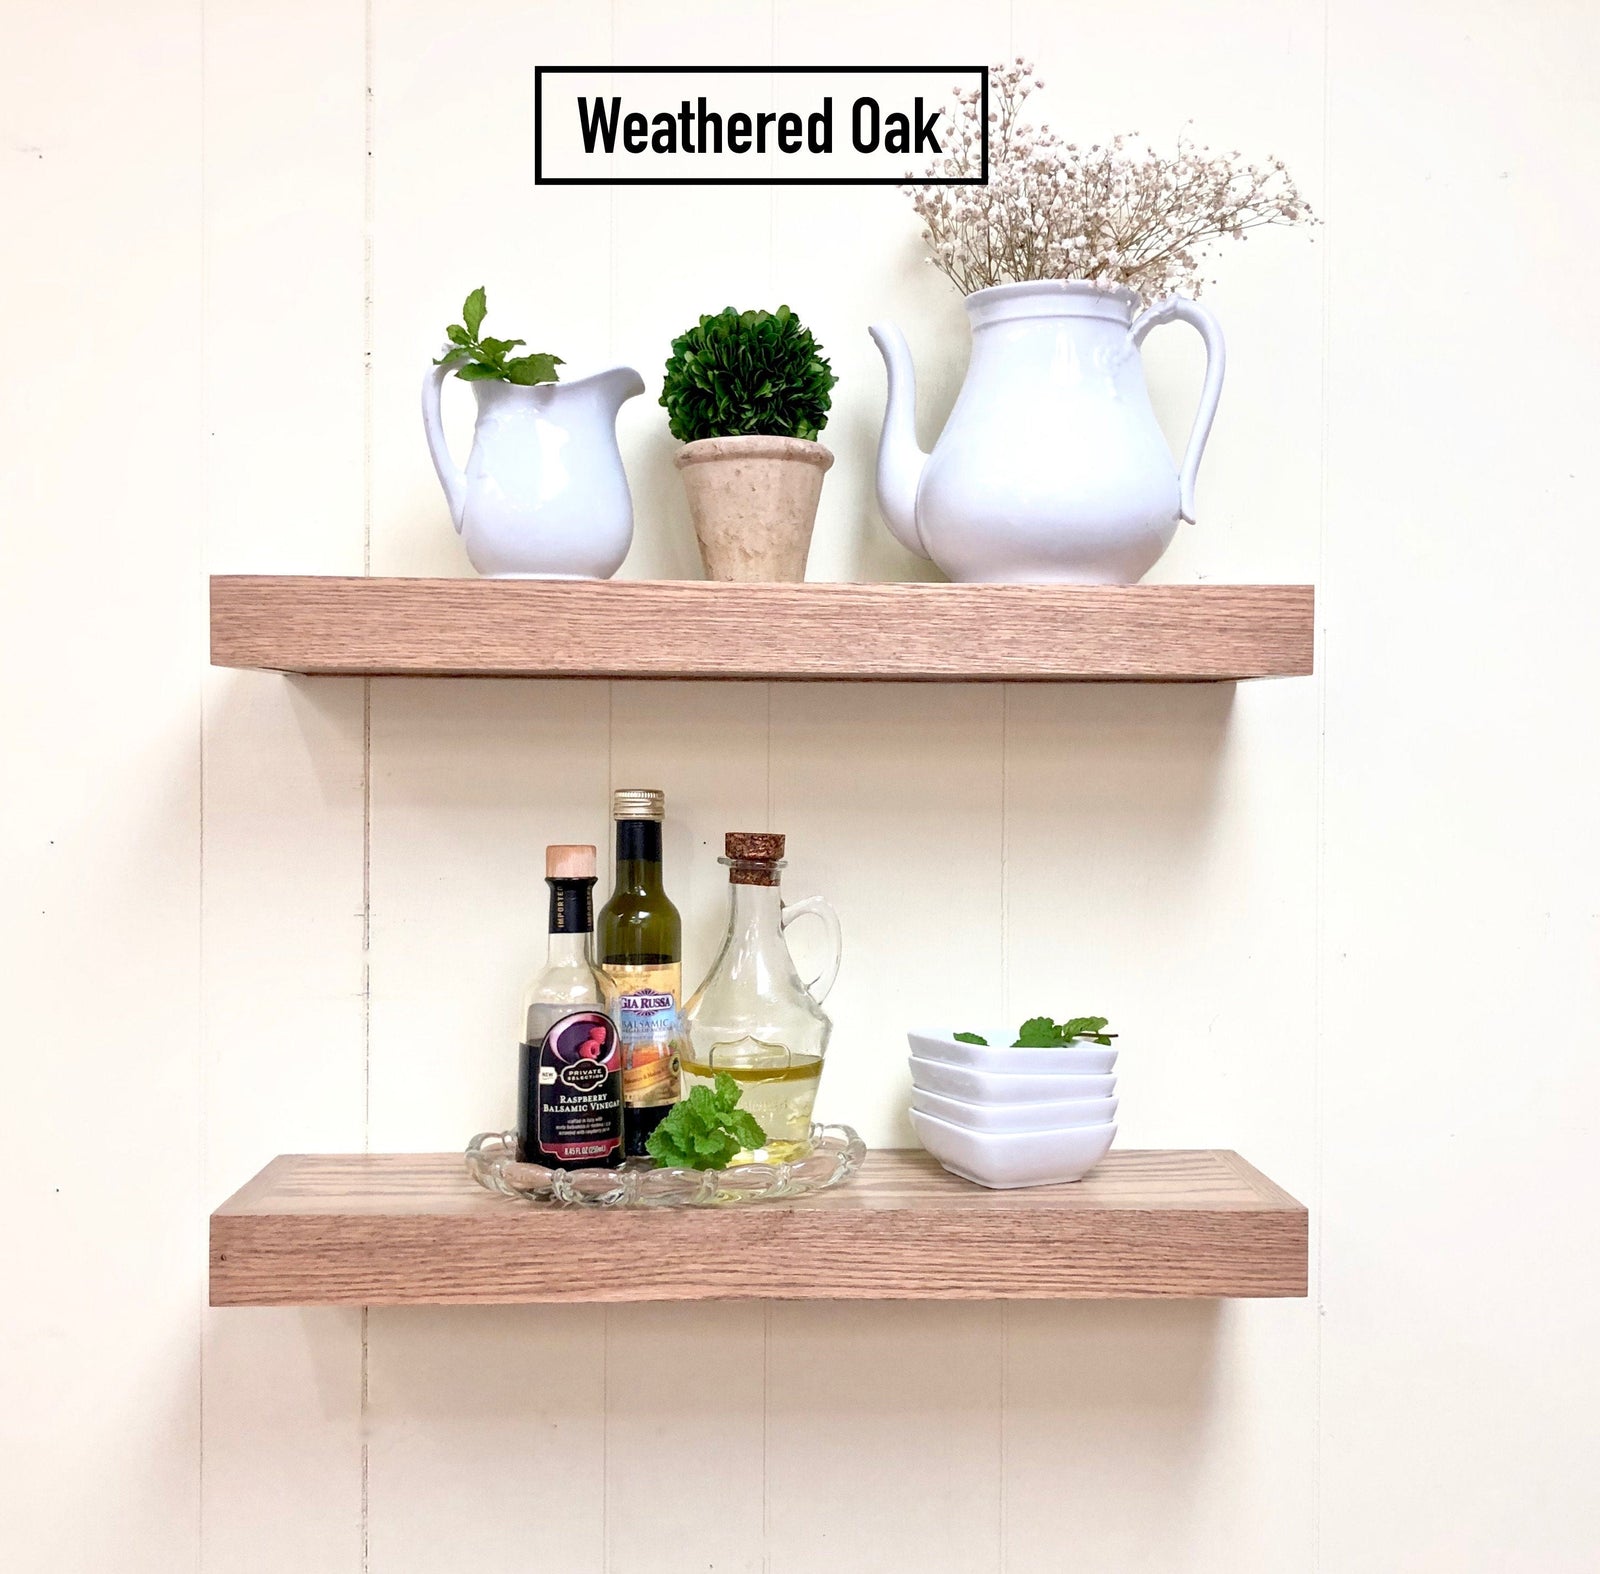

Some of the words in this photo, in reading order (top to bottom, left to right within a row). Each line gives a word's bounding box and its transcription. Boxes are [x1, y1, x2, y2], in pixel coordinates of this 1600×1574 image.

[640, 996, 671, 1009] RUSSA
[560, 1094, 607, 1103] RASPBERRY
[543, 1104, 588, 1112] BALSAMIC
